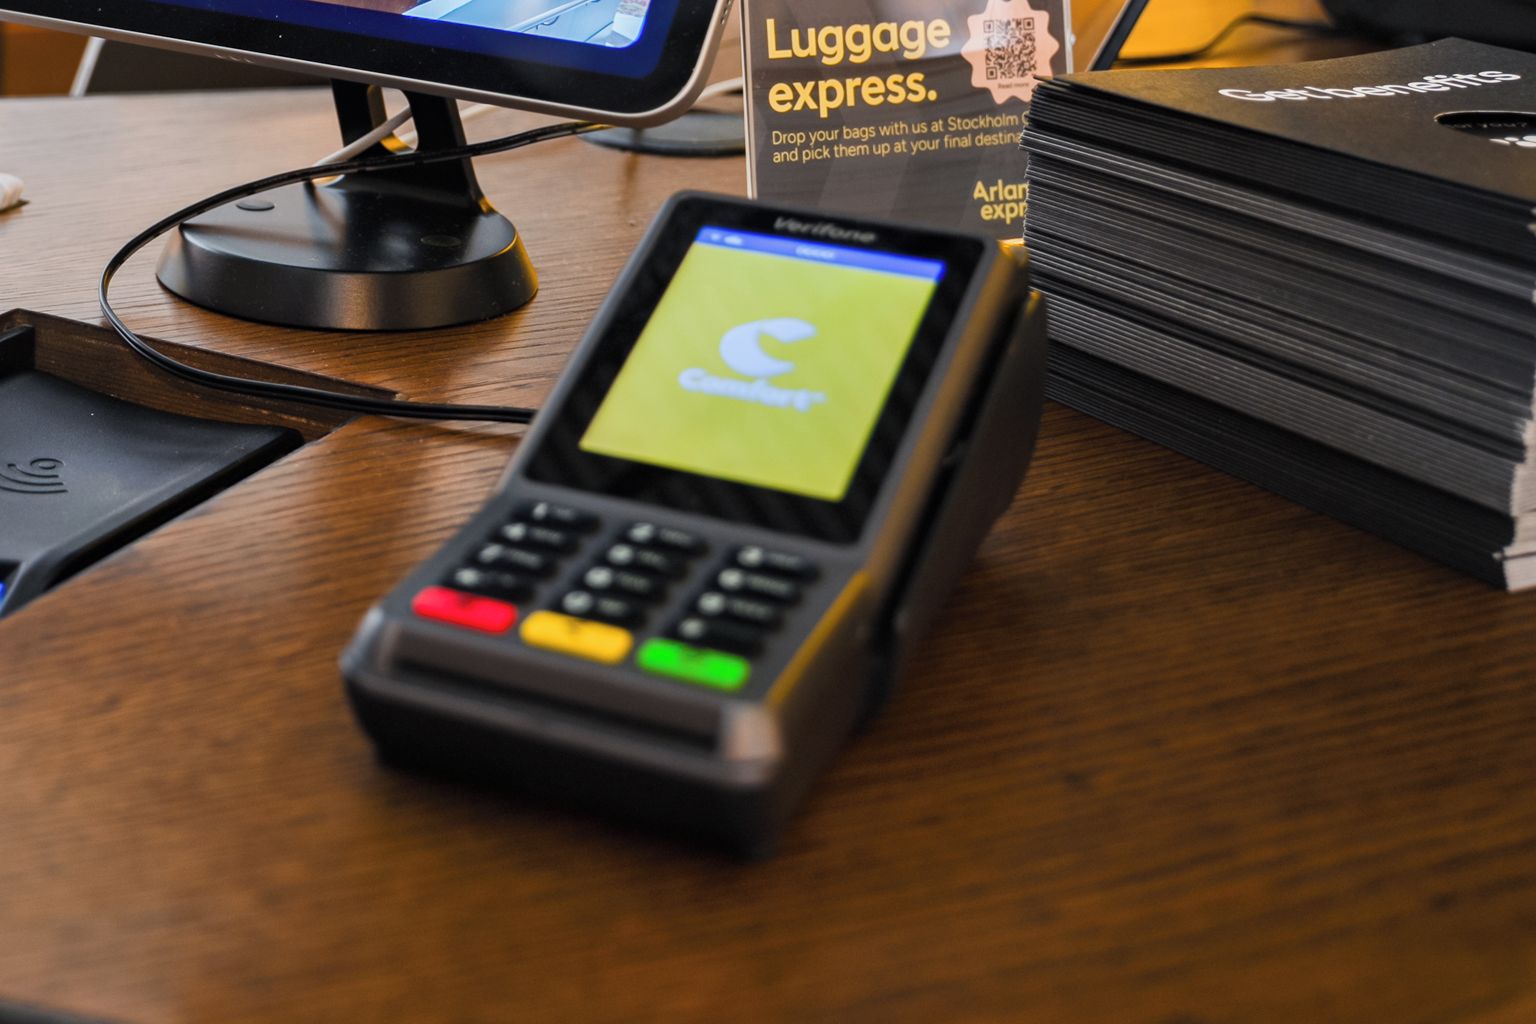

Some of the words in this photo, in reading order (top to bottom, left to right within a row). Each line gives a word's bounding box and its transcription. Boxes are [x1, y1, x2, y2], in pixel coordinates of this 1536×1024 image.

[766, 17, 952, 66] Luggage
[768, 71, 938, 118] express.
[1218, 87, 1332, 102] Get
[1304, 70, 1521, 99] benefits
[772, 131, 806, 147] Drop
[809, 130, 839, 146] your
[843, 126, 875, 142] bags
[879, 122, 909, 137] with
[912, 122, 928, 134] us
[931, 120, 944, 132] at
[947, 113, 1019, 131] Stockholm
[772, 147, 799, 163] and
[802, 146, 830, 164] pick
[834, 143, 869, 158] them
[873, 143, 891, 158] up
[894, 140, 907, 153] at
[910, 139, 940, 155] your
[944, 134, 972, 149] final
